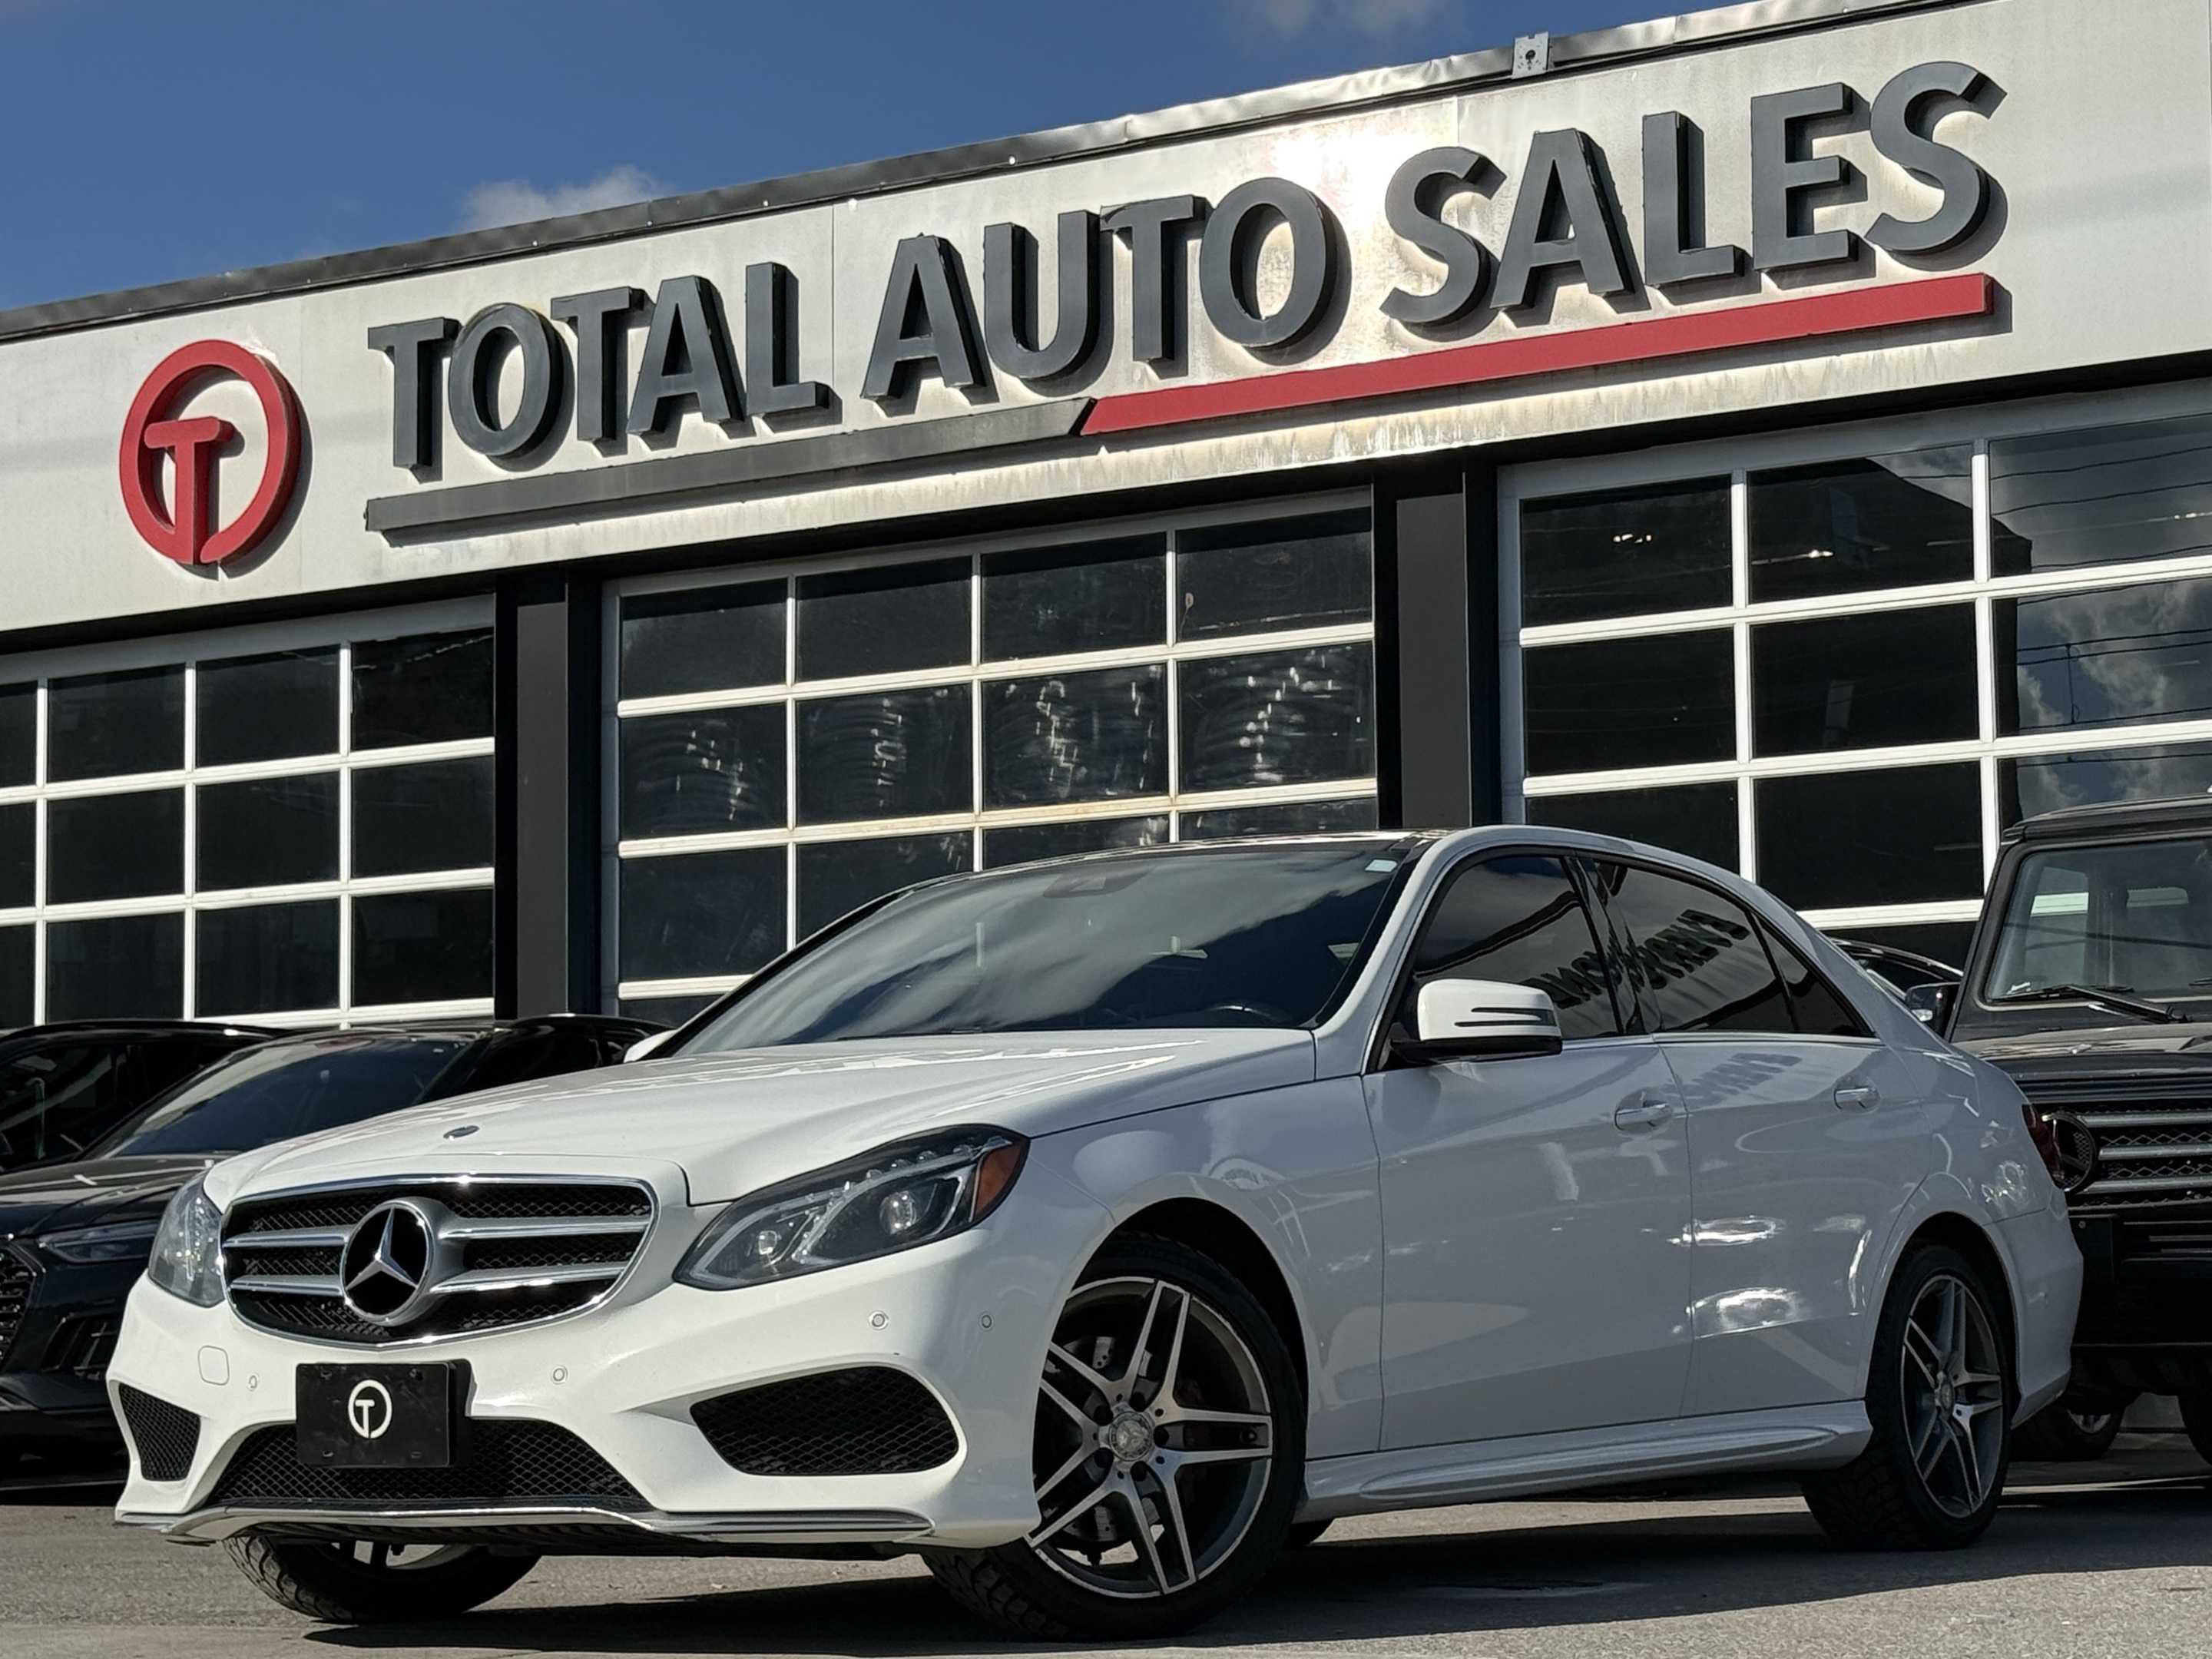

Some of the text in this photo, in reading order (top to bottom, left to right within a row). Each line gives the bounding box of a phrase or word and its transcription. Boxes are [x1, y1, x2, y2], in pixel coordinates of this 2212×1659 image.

[367, 61, 2003, 469] TOTAL AUTO SALES
